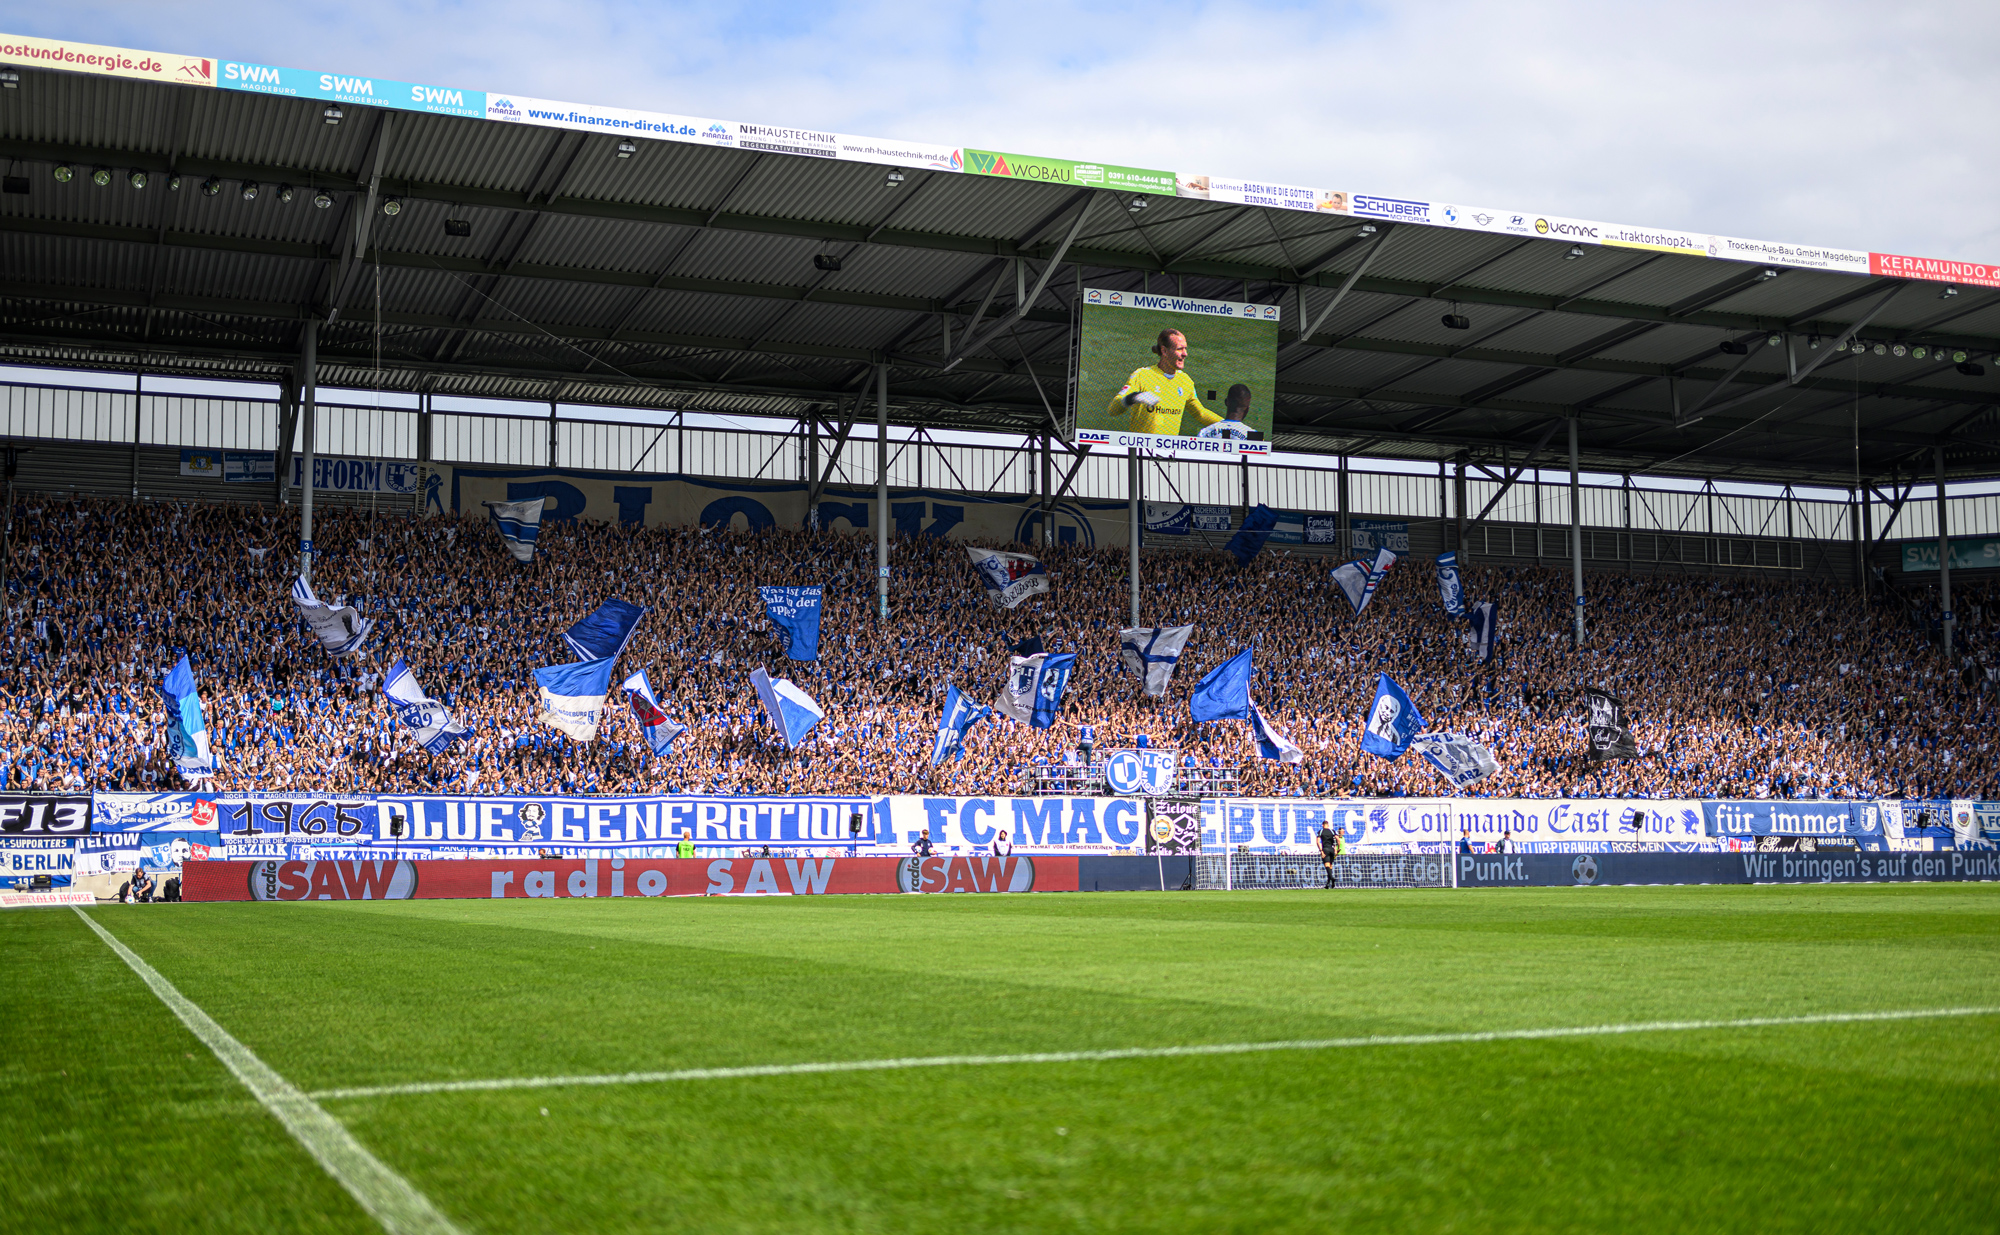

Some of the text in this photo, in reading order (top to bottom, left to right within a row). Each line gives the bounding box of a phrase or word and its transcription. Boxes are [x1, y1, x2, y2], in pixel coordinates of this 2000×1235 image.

[224, 63, 280, 84] SWM
[240, 83, 297, 95] MAGDEBURG
[319, 74, 373, 96] SWM
[335, 94, 389, 105] MAGDEBURG
[411, 86, 464, 106] SWM
[426, 104, 479, 116] MAGDEBURG
[488, 107, 521, 116] FINANZEN
[528, 108, 696, 136] www.finanzen-direkt.de
[702, 131, 733, 141] FINANZEN
[741, 141, 835, 156] REGENERATIVE ENERGIEN
[842, 145, 949, 162] www.nh-haustechnik-md.de
[1012, 163, 1070, 183] WOBAU
[1127, 174, 1158, 183] 610-4444
[1211, 182, 1314, 200] Lustinetz BADEN WIE DIE GÖTTER
[1244, 195, 1314, 210] EINMAL IMMER
[1353, 194, 1430, 217] SCHUBERT
[1389, 214, 1426, 223] MOTORS
[1550, 222, 1598, 238] VEMAC
[1605, 230, 1705, 250] www.traktorshop24.com
[1727, 240, 1867, 264] Trocken-Aus-Bau GmbH Magdeburg
[1781, 257, 1828, 267] Ausbauprofi
[1134, 295, 1233, 315] MWG-Wohnen.de
[1079, 433, 1109, 441] DAF
[1118, 436, 1219, 451] CURT SCHRÖTER
[1239, 443, 1268, 451] DAF
[1193, 506, 1230, 514] ASCHERSLEBEN
[1307, 516, 1334, 527] Fanclub
[1358, 521, 1403, 531] Fanclub
[1352, 534, 1408, 548] 19 65
[787, 587, 799, 596] ist
[802, 587, 821, 596] das
[786, 595, 793, 607] in
[796, 597, 817, 607] der
[400, 702, 438, 718] BEZIRK
[121, 798, 193, 814] BÖRDE
[232, 801, 365, 836] 1965
[377, 802, 870, 842] BLUE GENERATION
[1398, 804, 1675, 835] Commando East Side
[1715, 804, 1849, 834] für immer
[227, 844, 288, 856] BEZIRK
[1612, 842, 1665, 852] ROSSWEIN
[13, 854, 73, 870] BERLIN
[1208, 857, 1250, 883] Wir
[1366, 856, 1406, 882] auf
[1413, 856, 1455, 882] den
[1461, 856, 1529, 880] Punkt.
[1743, 854, 1776, 878] Wir
[1878, 853, 1906, 876] auf
[1912, 853, 1945, 876] den
[262, 861, 276, 899] radio
[276, 860, 399, 900] SAW
[492, 859, 836, 898] radio SAW
[907, 857, 920, 892] radio
[920, 857, 1018, 892] SAW
